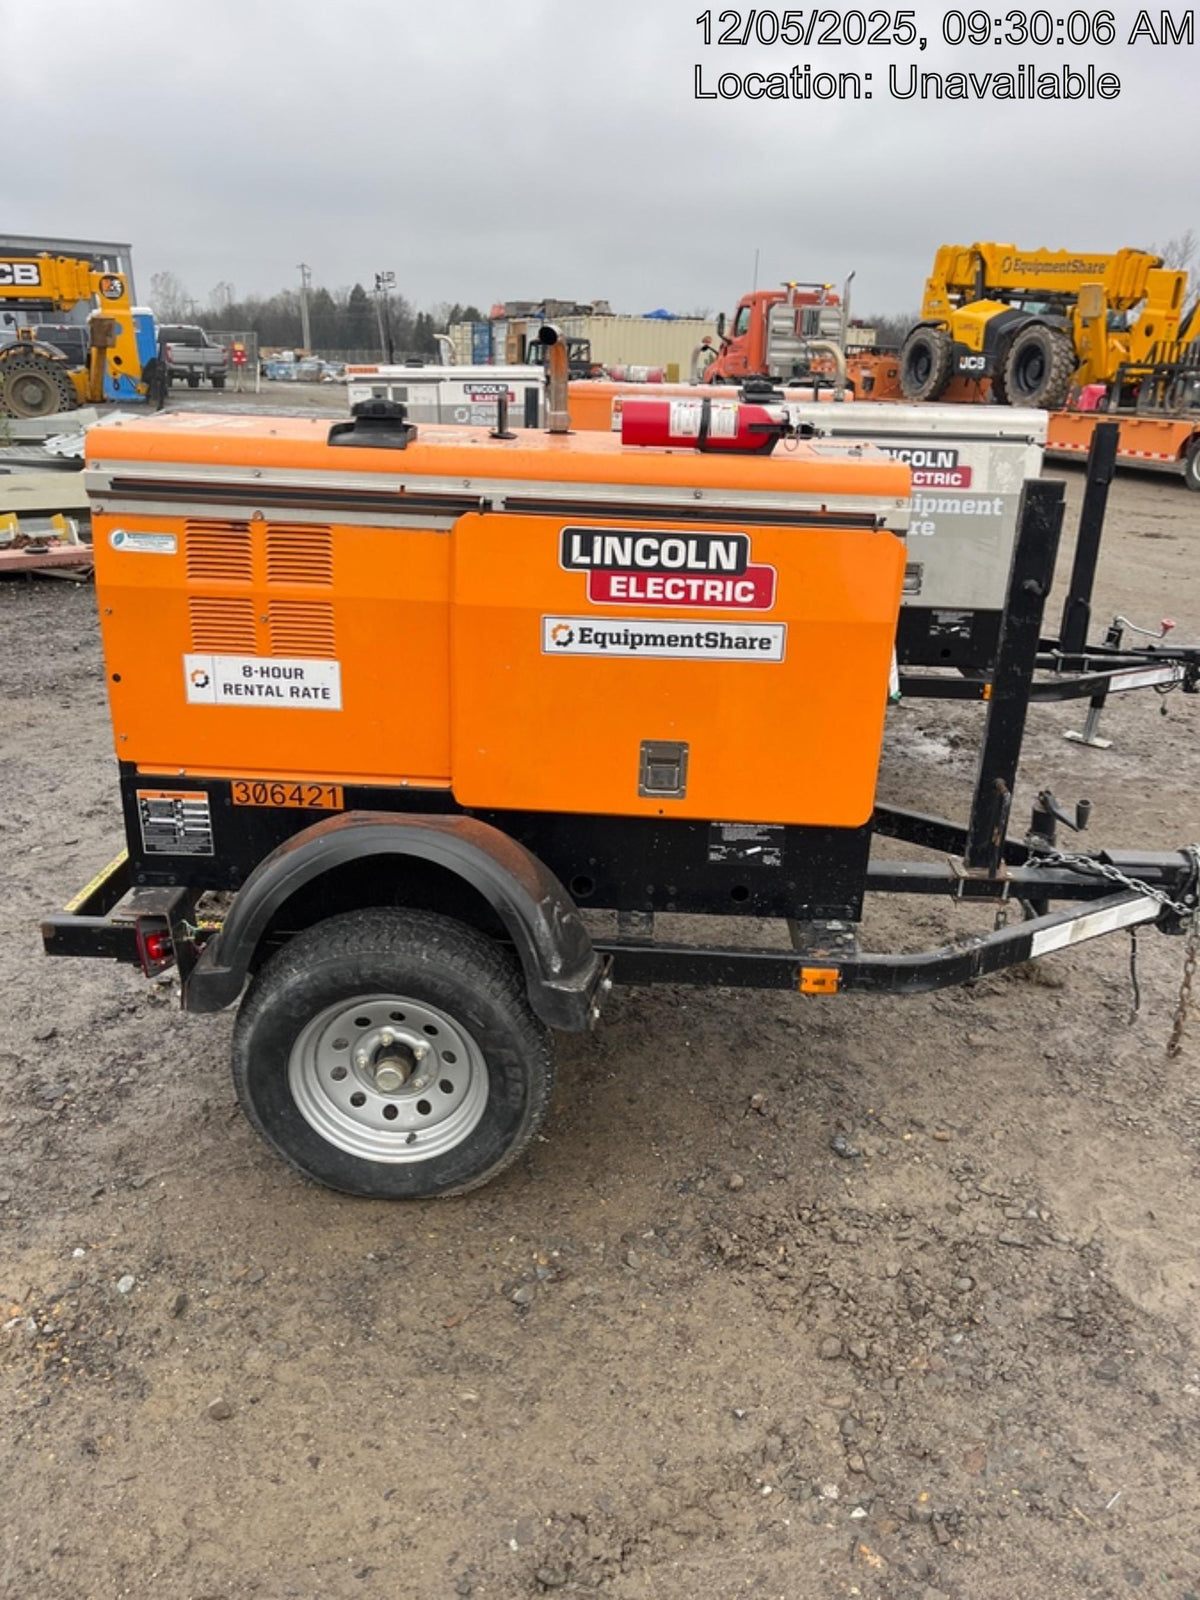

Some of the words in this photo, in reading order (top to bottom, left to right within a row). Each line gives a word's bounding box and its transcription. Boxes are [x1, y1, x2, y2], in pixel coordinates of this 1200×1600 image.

[0, 263, 40, 285] CB
[1013, 256, 1106, 275] EquipmentShare
[912, 471, 963, 486] CTRIC
[910, 493, 1004, 517] ipment
[571, 534, 738, 570] LINCOLN
[609, 575, 755, 604] ELECTRIC
[578, 627, 772, 652] EquipmentShare
[242, 664, 305, 680] 8-HOUR
[223, 682, 284, 698] RENTAL
[290, 685, 331, 700] RATE
[234, 781, 339, 808] 306421
